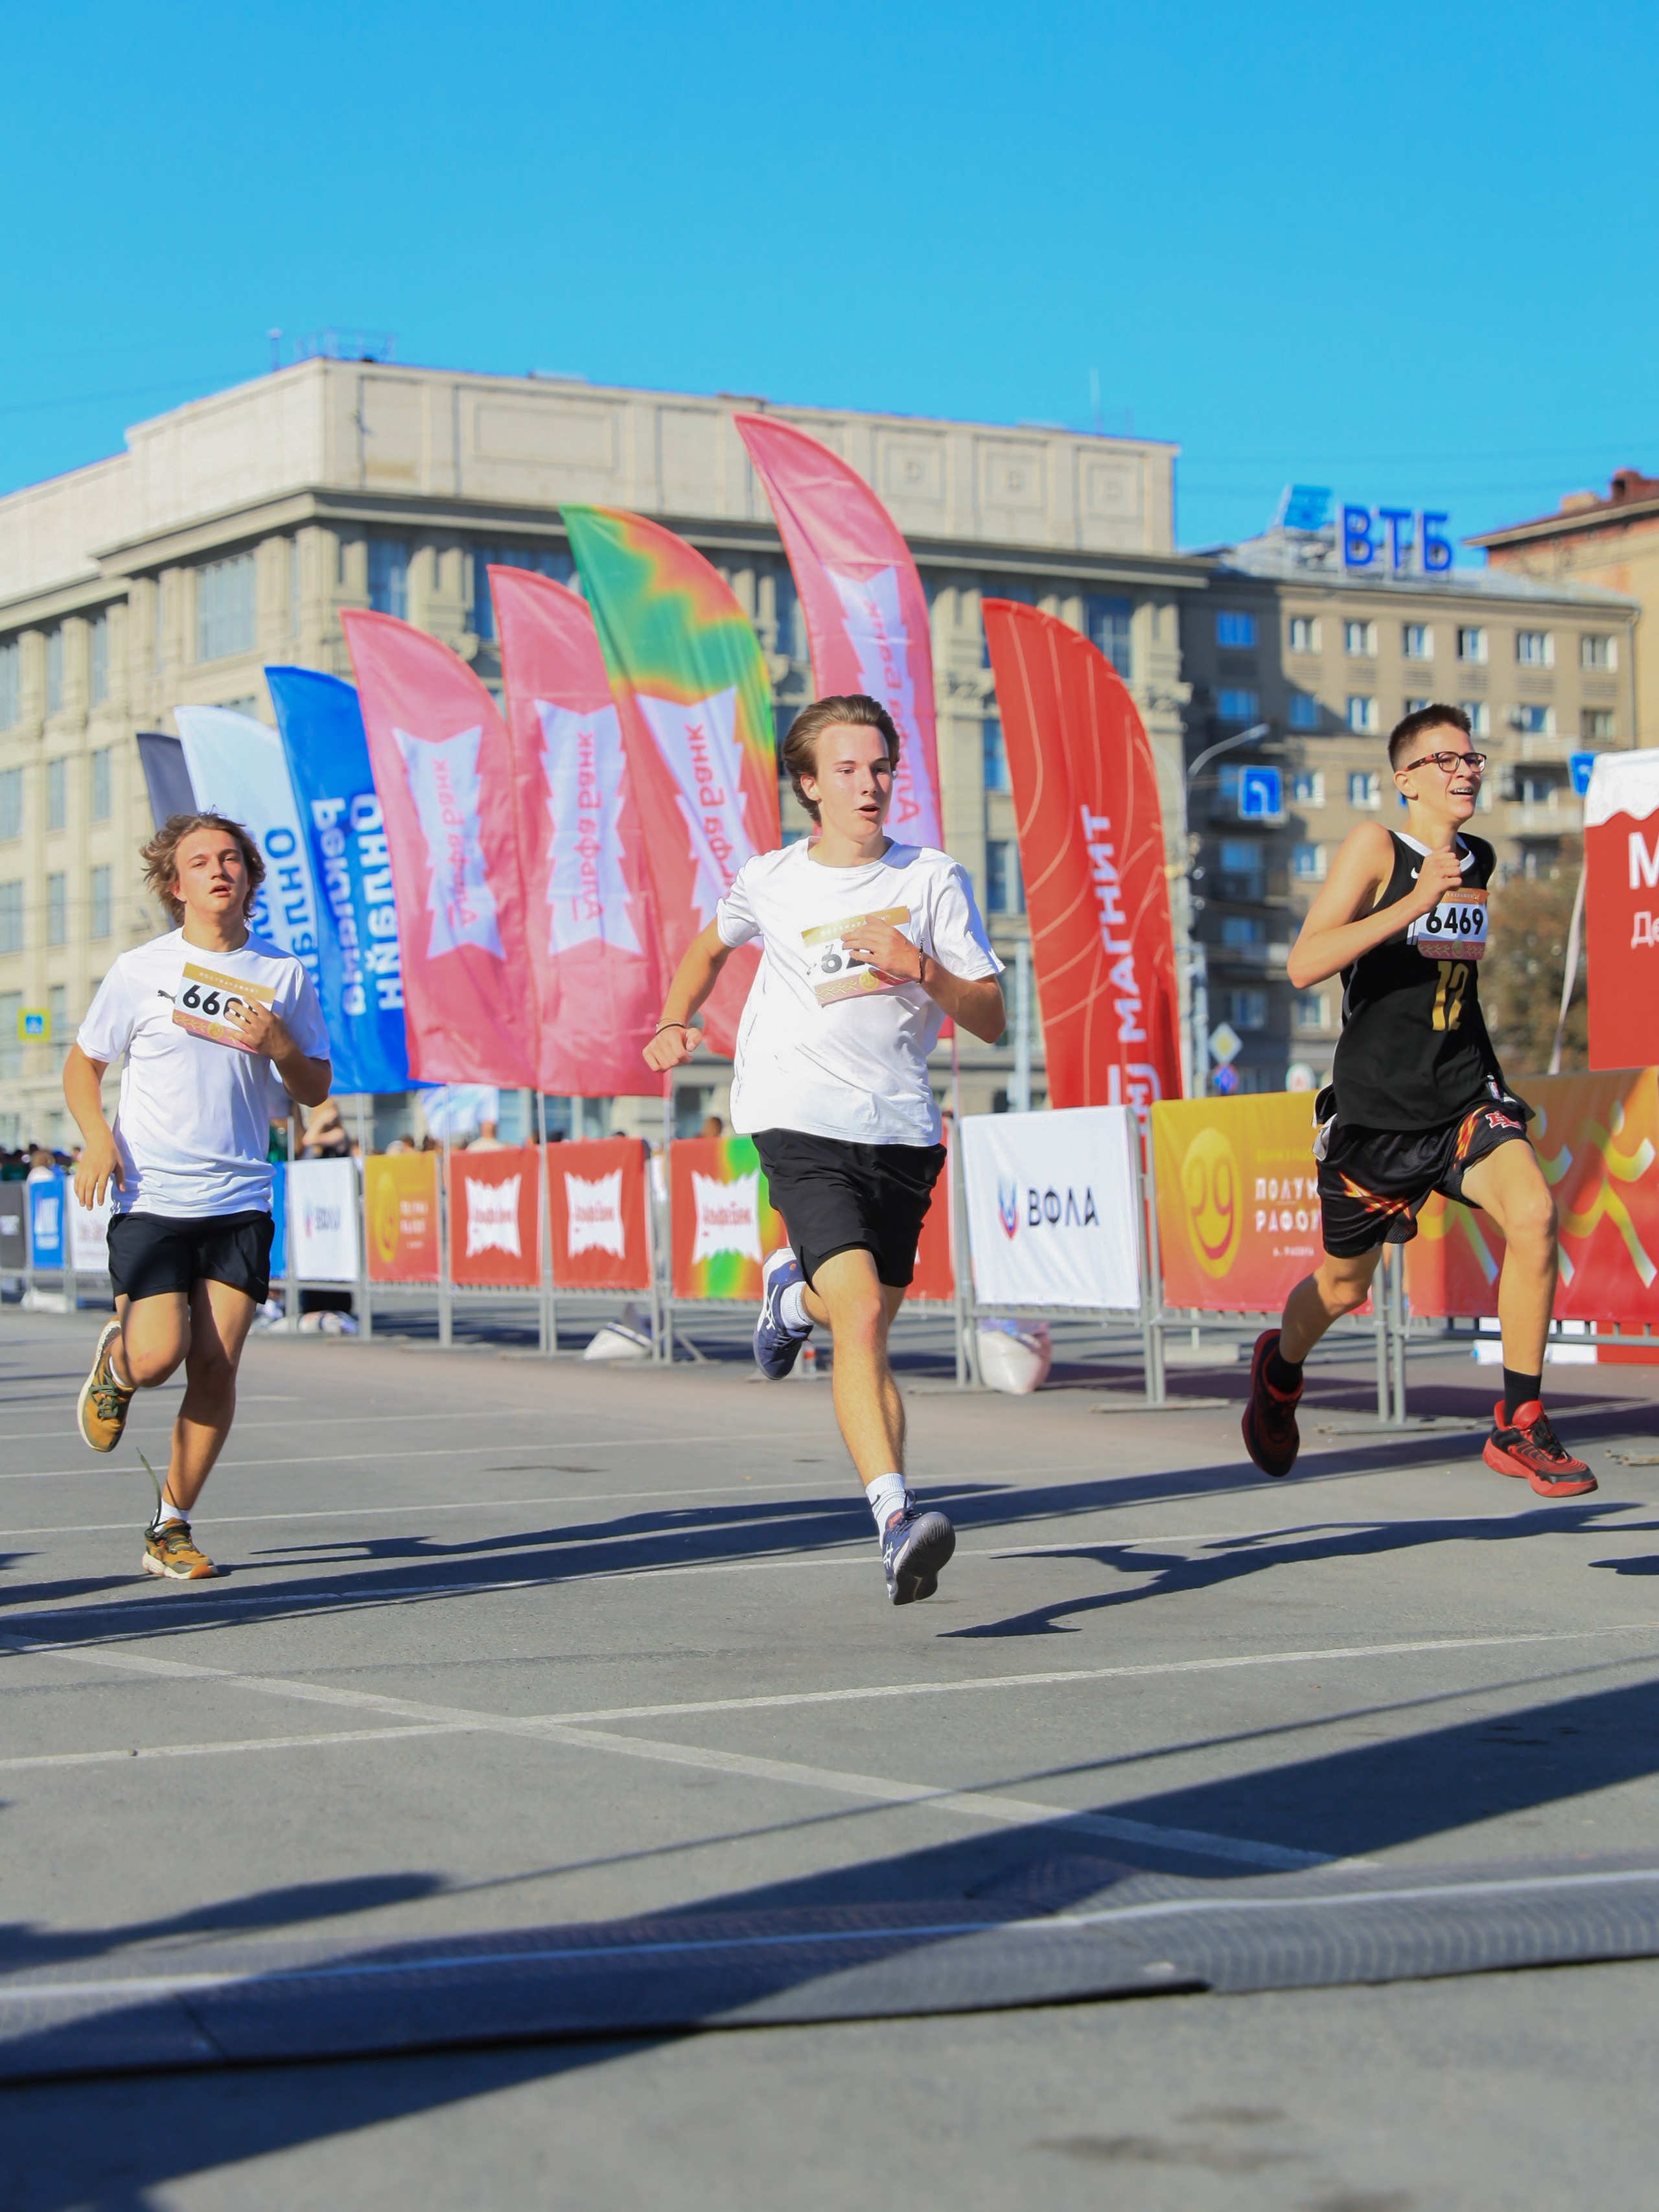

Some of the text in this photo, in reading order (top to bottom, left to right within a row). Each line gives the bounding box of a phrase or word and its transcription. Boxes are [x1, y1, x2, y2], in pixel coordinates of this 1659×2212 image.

[1341, 504, 1454, 572] ВТБ
[1080, 804, 1146, 1043] МАГНИТ
[1426, 906, 1484, 935] 6469
[1255, 1178, 1319, 1201] ПОЛУМ
